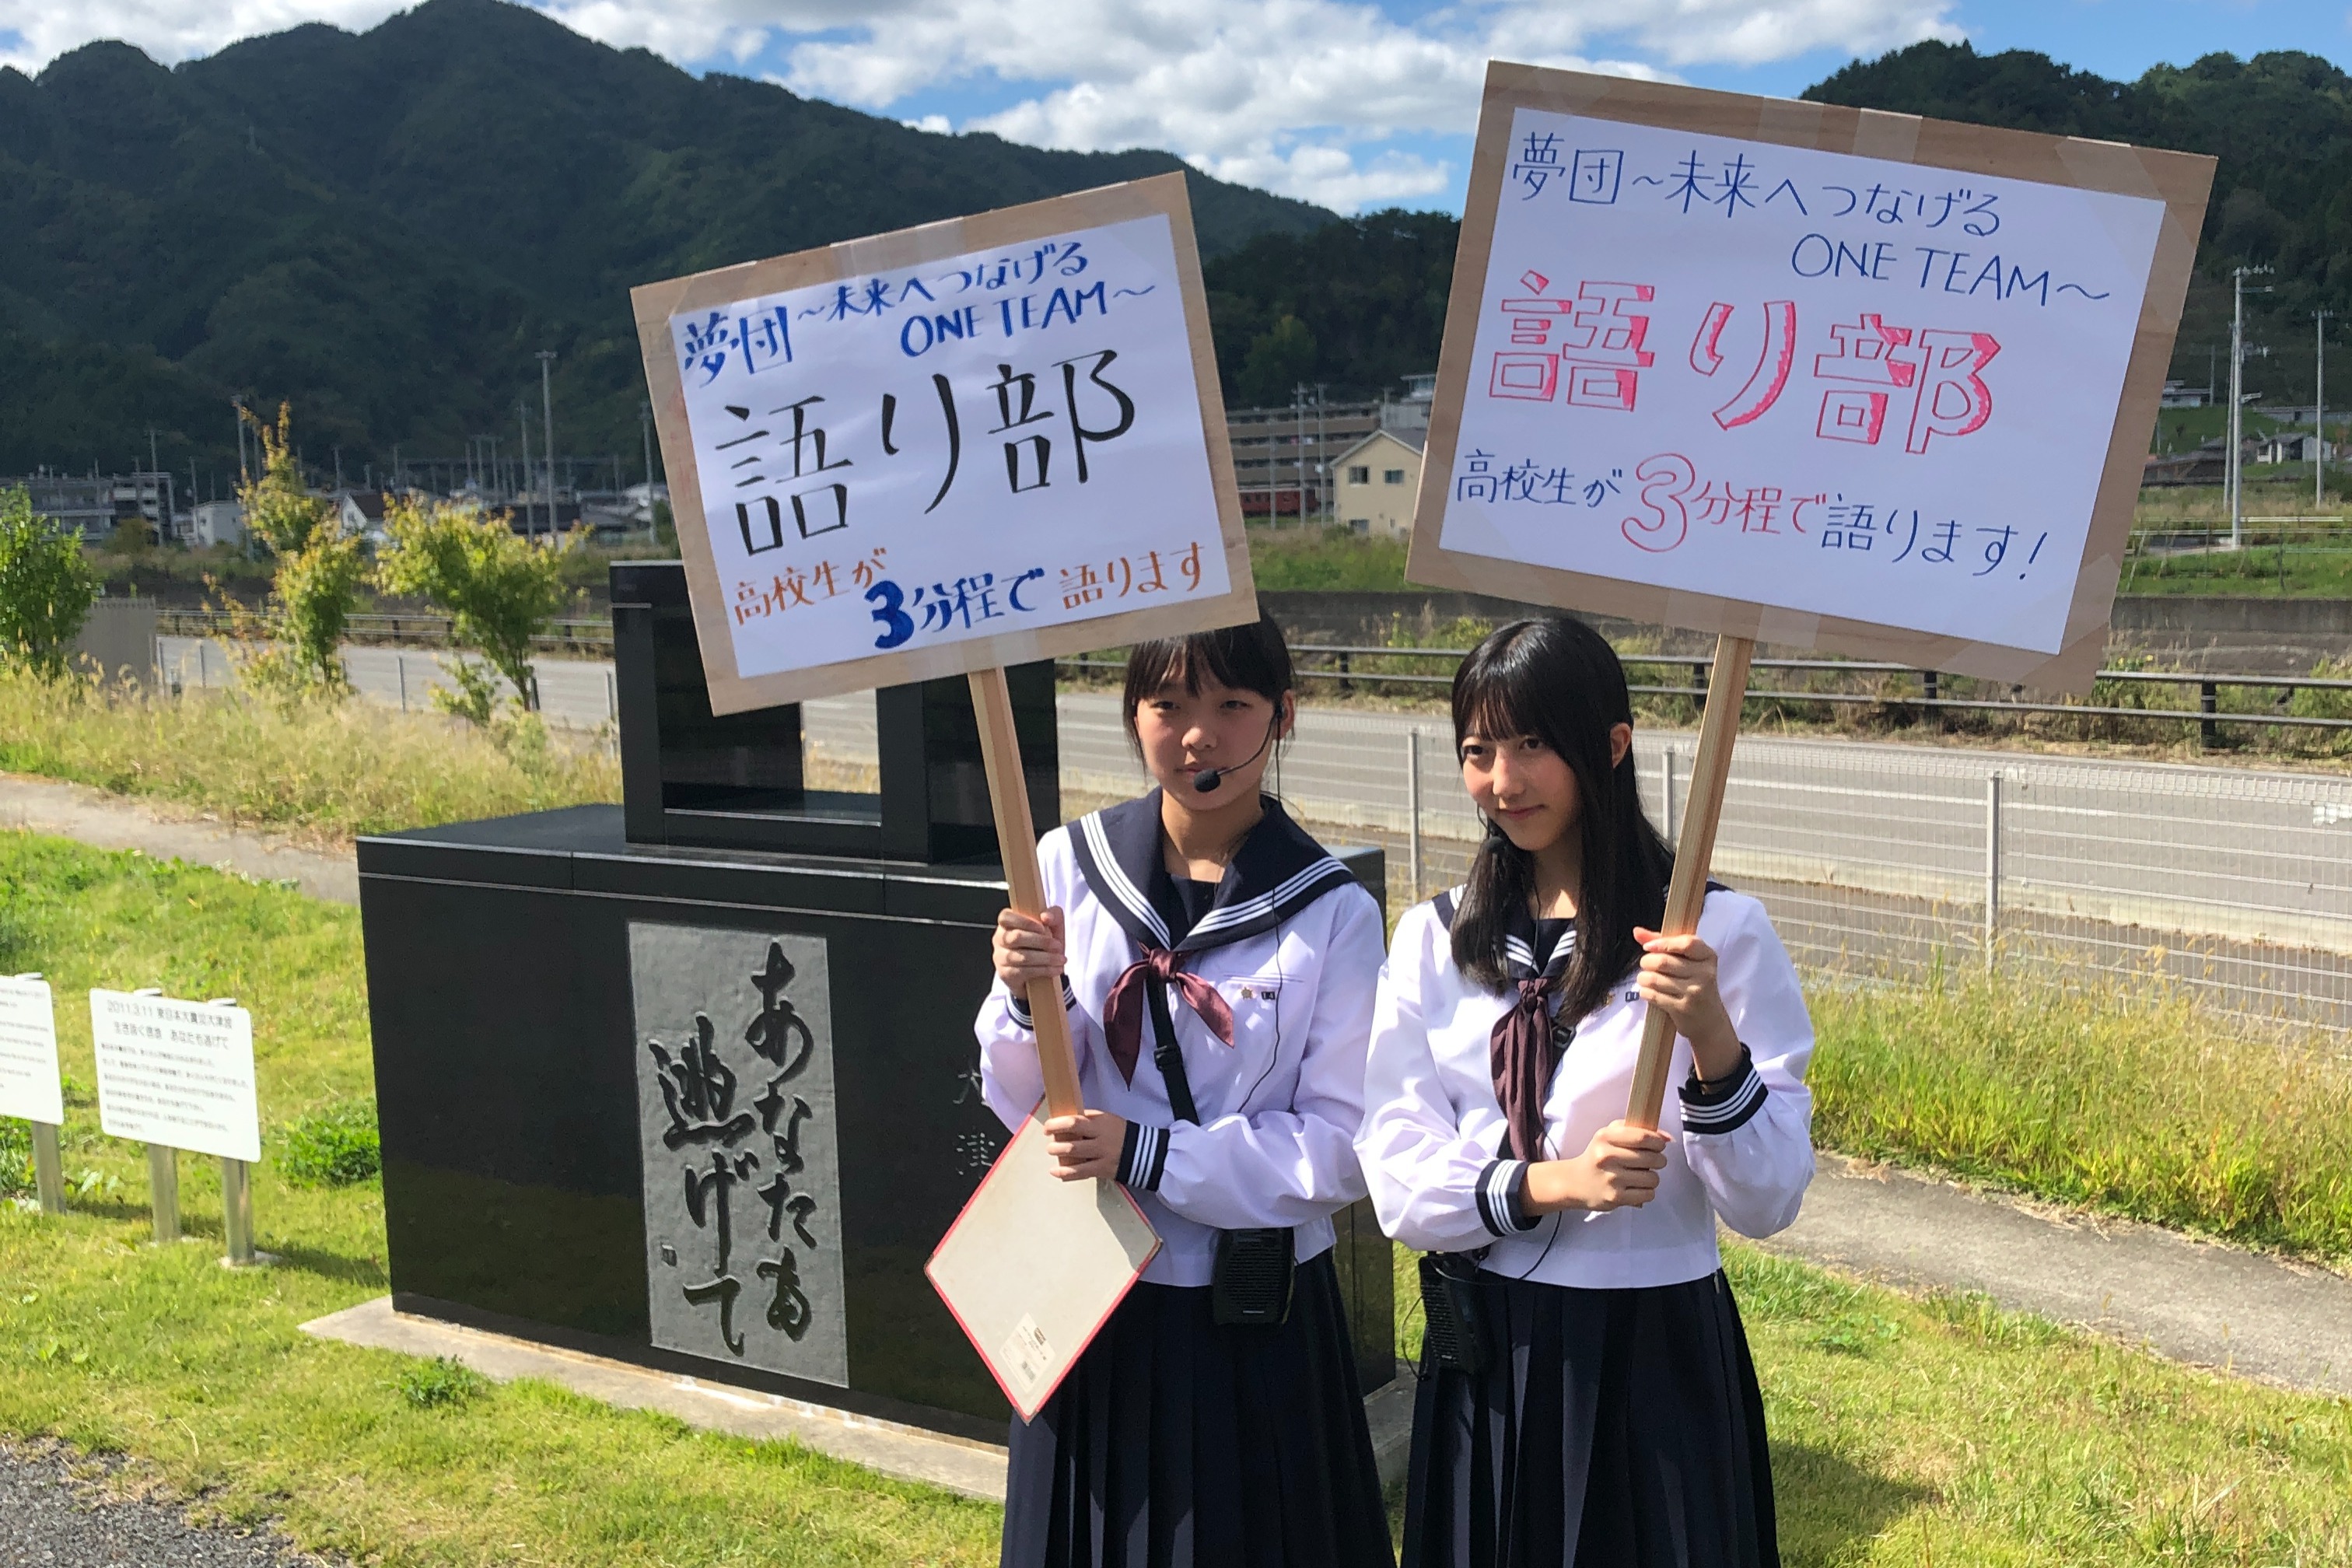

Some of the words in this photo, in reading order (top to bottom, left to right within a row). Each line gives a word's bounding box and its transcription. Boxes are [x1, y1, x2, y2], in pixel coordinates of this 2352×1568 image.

[1791, 233, 1897, 281] ONE
[900, 306, 982, 358] ONE
[1489, 269, 2001, 454] 語り部
[715, 349, 1135, 557] 語り部
